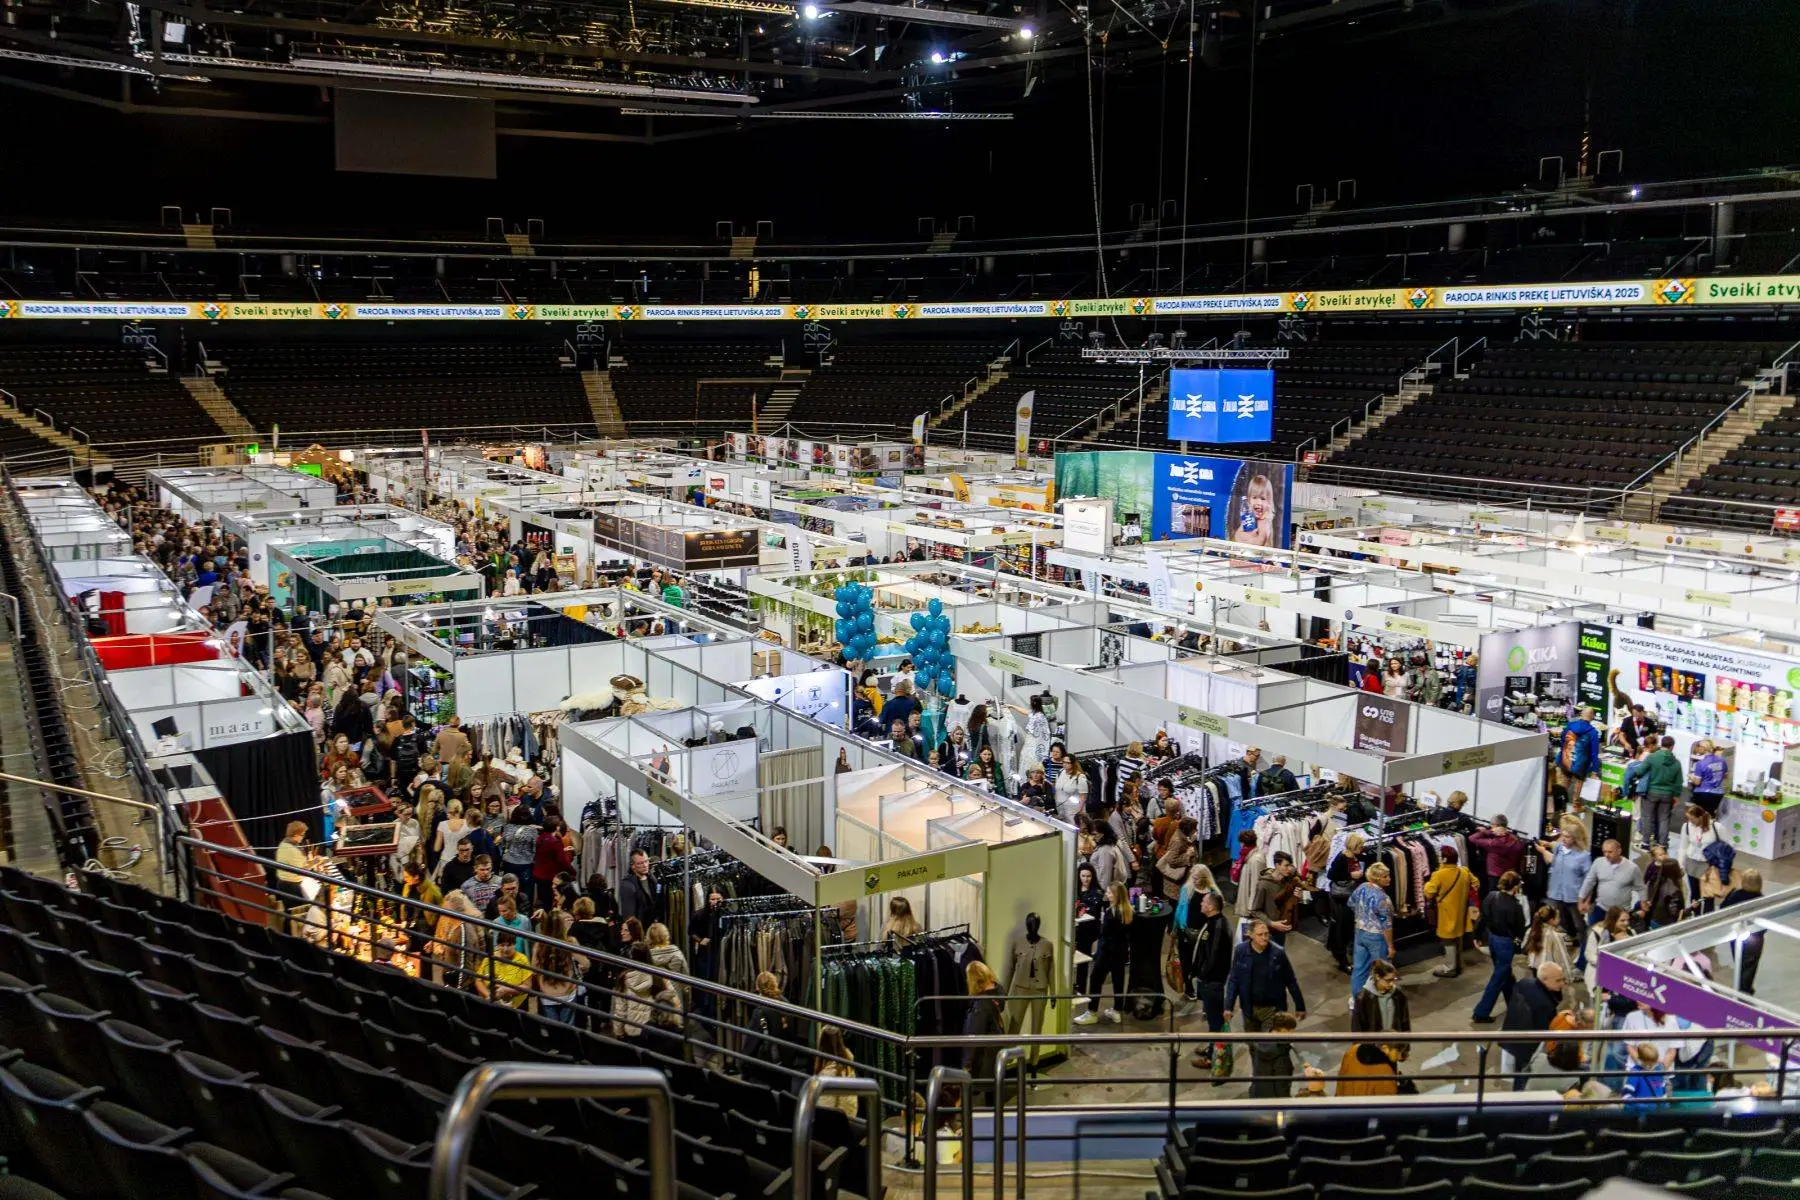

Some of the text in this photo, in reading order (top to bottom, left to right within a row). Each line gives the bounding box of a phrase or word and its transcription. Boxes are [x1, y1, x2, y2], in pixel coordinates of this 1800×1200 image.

[1446, 292, 1483, 302] PARODA
[1486, 292, 1516, 301] RINKIS
[1614, 288, 1640, 298] 2025
[1710, 282, 1764, 297] Sveiki
[1264, 298, 1280, 307] 2025
[1320, 294, 1396, 308] Sveiki atvykę!
[25, 306, 60, 314] PARODA
[63, 306, 91, 314] RINKIS
[168, 307, 187, 315] 2025
[234, 306, 313, 318] Sveiki atvykę!
[542, 307, 609, 318] Sveiki atvykę!
[820, 307, 884, 318] Sveiki atvykę!
[1028, 305, 1044, 313] 2025
[1074, 304, 1097, 312] Sveiki
[1582, 636, 1607, 650] Kika
[1620, 637, 1662, 650] VISAVERTIS
[1664, 642, 1696, 657] ŠLAPIAS
[1528, 646, 1558, 664] KIKA
[1682, 658, 1710, 668] VIENAS
[210, 721, 262, 735] maar
[897, 866, 928, 879] PAKAITA
